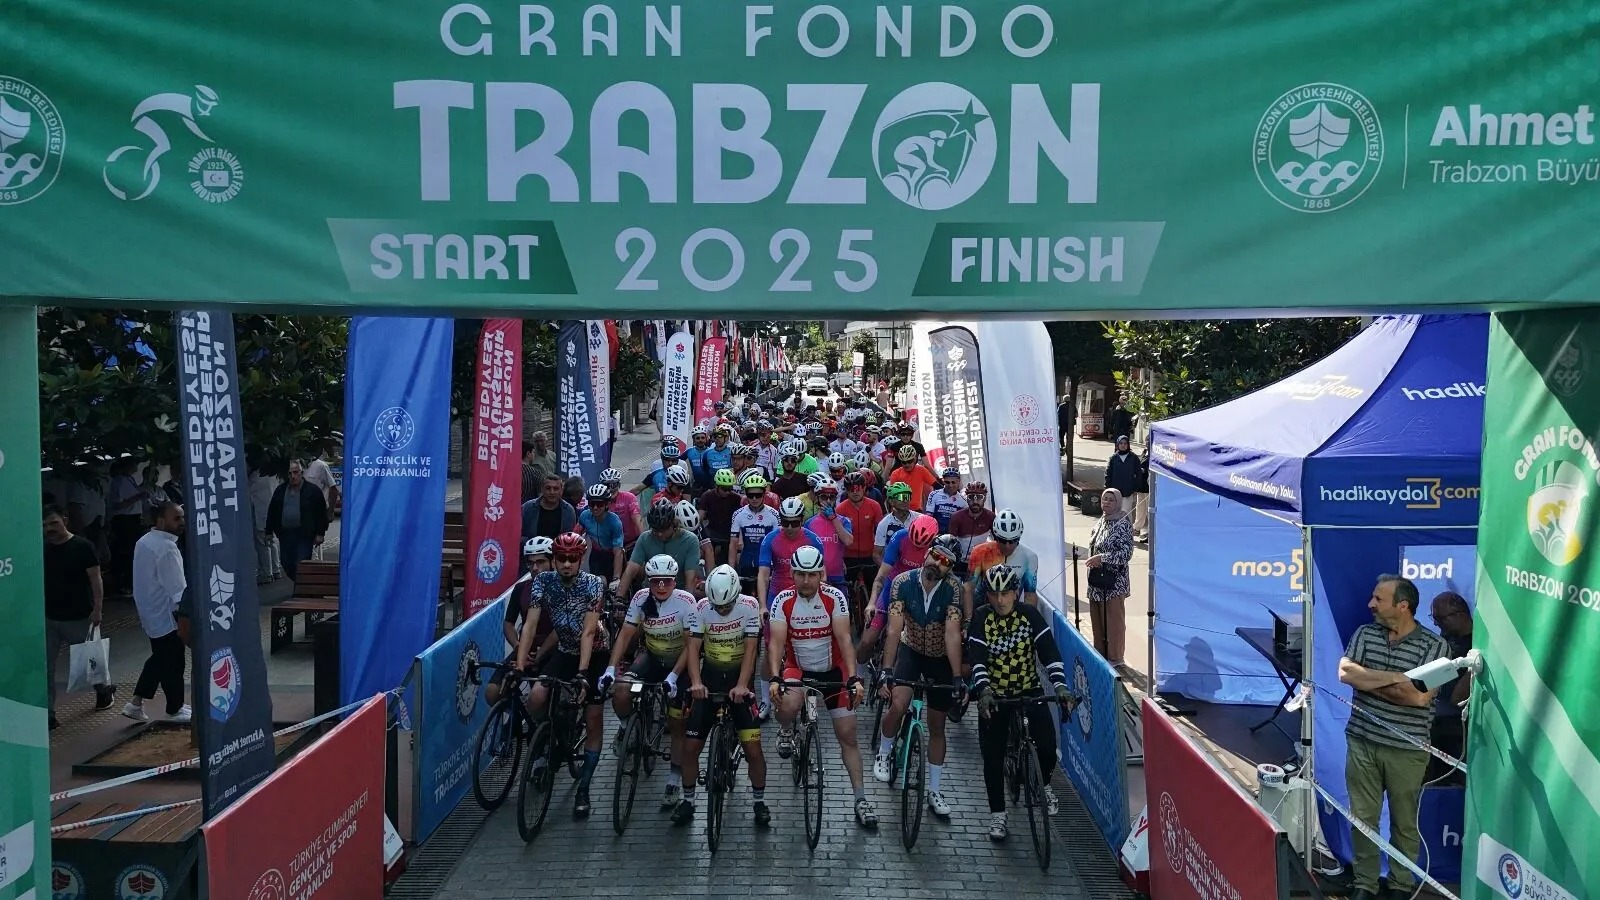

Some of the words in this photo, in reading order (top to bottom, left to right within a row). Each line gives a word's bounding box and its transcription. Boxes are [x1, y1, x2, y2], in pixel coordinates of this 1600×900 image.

[440, 3, 681, 57] GRAN
[745, 4, 1054, 58] FONDO
[393, 80, 1101, 210] TRABZON
[1257, 110, 1282, 164] TRABZON
[1429, 103, 1595, 147] Ahmet
[1429, 159, 1527, 184] Trabzon
[1303, 198, 1331, 209] 1868
[370, 233, 539, 281] START
[614, 226, 878, 293] 2025
[950, 236, 1124, 283] FINISH
[921, 372, 934, 432] TRABZON
[967, 380, 984, 469] BELEDİYESİ
[942, 393, 956, 463] TRABZON
[353, 455, 373, 465] T.C.
[375, 454, 418, 467] GENÇLİK
[420, 456, 431, 466] VE
[1514, 426, 1556, 481] GRAN
[770, 589, 796, 619] SALCANO
[820, 586, 847, 613] SALCANO
[1505, 565, 1564, 601] TRABZON
[708, 619, 742, 634] Asperox
[289, 834, 322, 876] TÜRKİYE
[323, 787, 369, 843] CUMHURİYETİ
[289, 851, 325, 897] GENÇLİK
[326, 840, 337, 859] VE
[337, 820, 358, 849] SPOR
[295, 861, 334, 900] KANLIĞI
